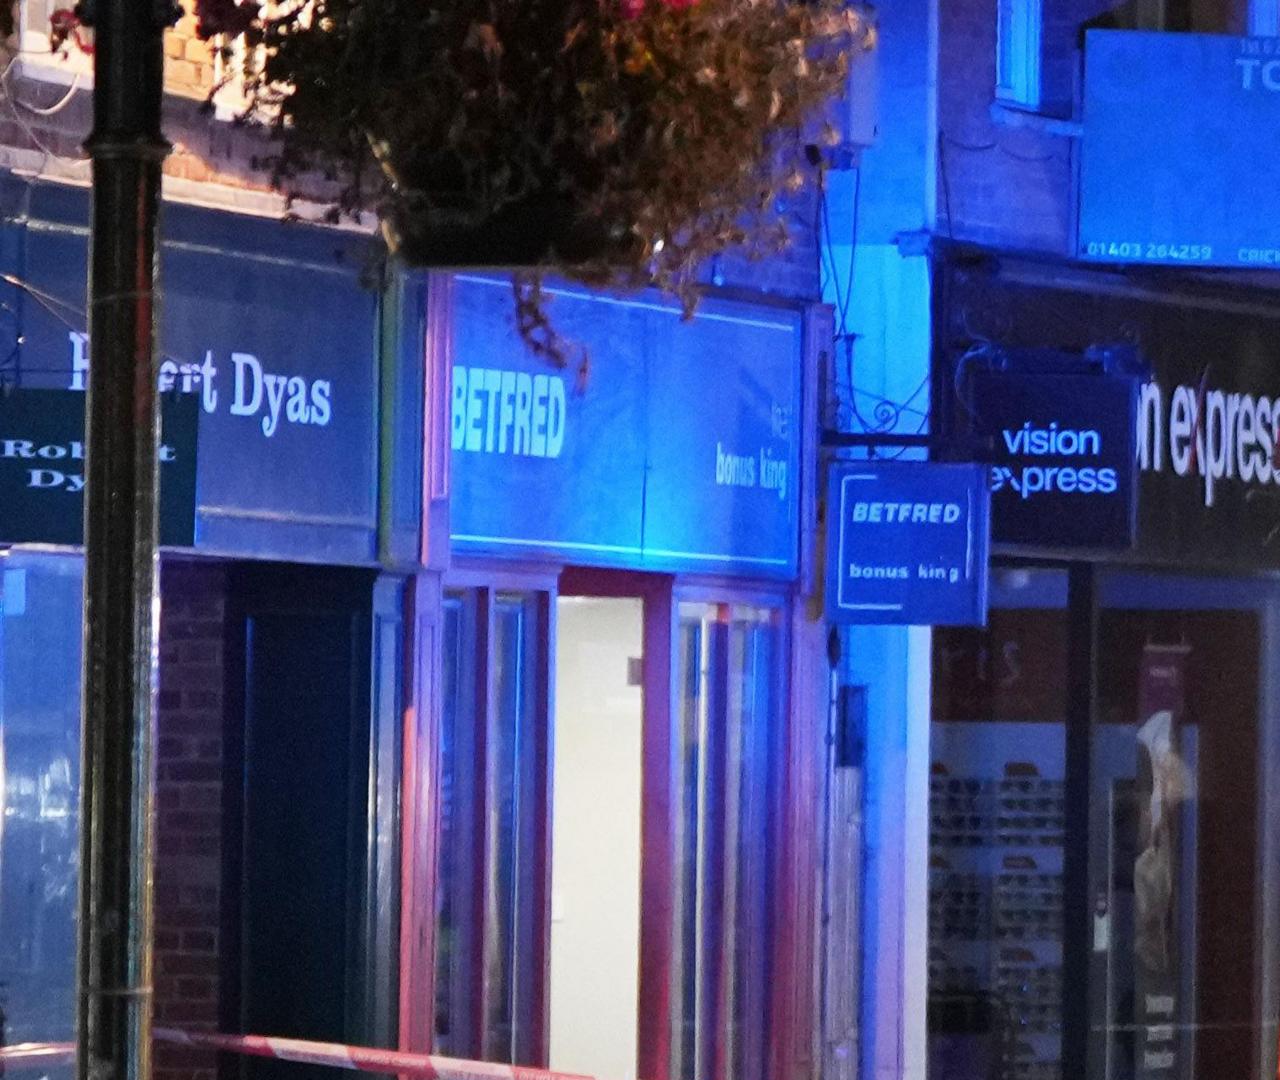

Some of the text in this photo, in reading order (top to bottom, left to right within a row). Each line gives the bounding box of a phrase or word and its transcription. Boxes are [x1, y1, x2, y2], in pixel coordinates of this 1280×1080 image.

[1087, 242, 1141, 258] 01403
[1145, 244, 1212, 260] 264259
[230, 352, 331, 437] Dyas
[452, 365, 566, 458] BETFRED
[1, 439, 177, 461] Rot
[1002, 421, 1100, 456] vision
[27, 468, 87, 492] Dy
[716, 441, 787, 500] bonus king
[991, 466, 1118, 498] express
[853, 502, 960, 523] BETFRED
[850, 563, 958, 583] bonus king
